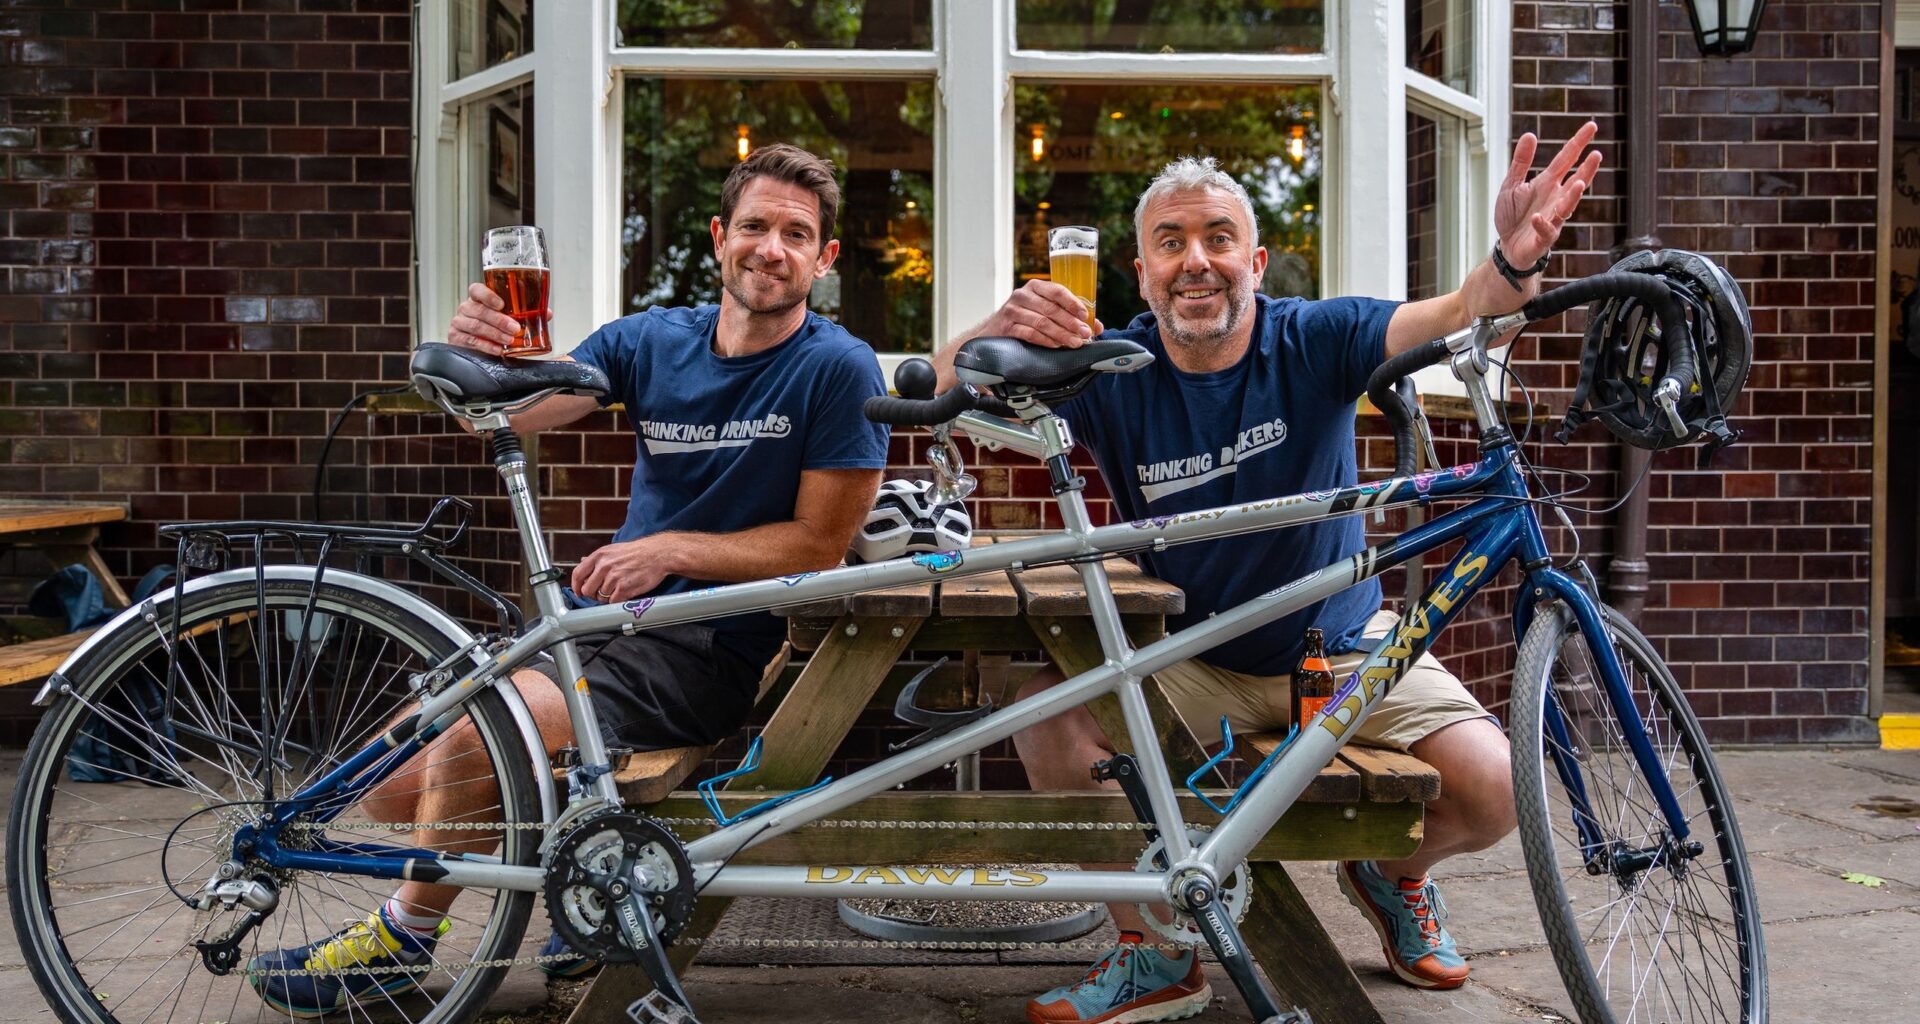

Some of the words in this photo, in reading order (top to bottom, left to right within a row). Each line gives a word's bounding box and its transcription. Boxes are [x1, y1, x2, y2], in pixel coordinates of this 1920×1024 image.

[640, 420, 716, 442] THINKING
[1137, 452, 1212, 483] THINKING
[1319, 551, 1489, 741] DAWES
[805, 865, 1048, 887] DAWES
[1205, 910, 1238, 957] TRUVATIV
